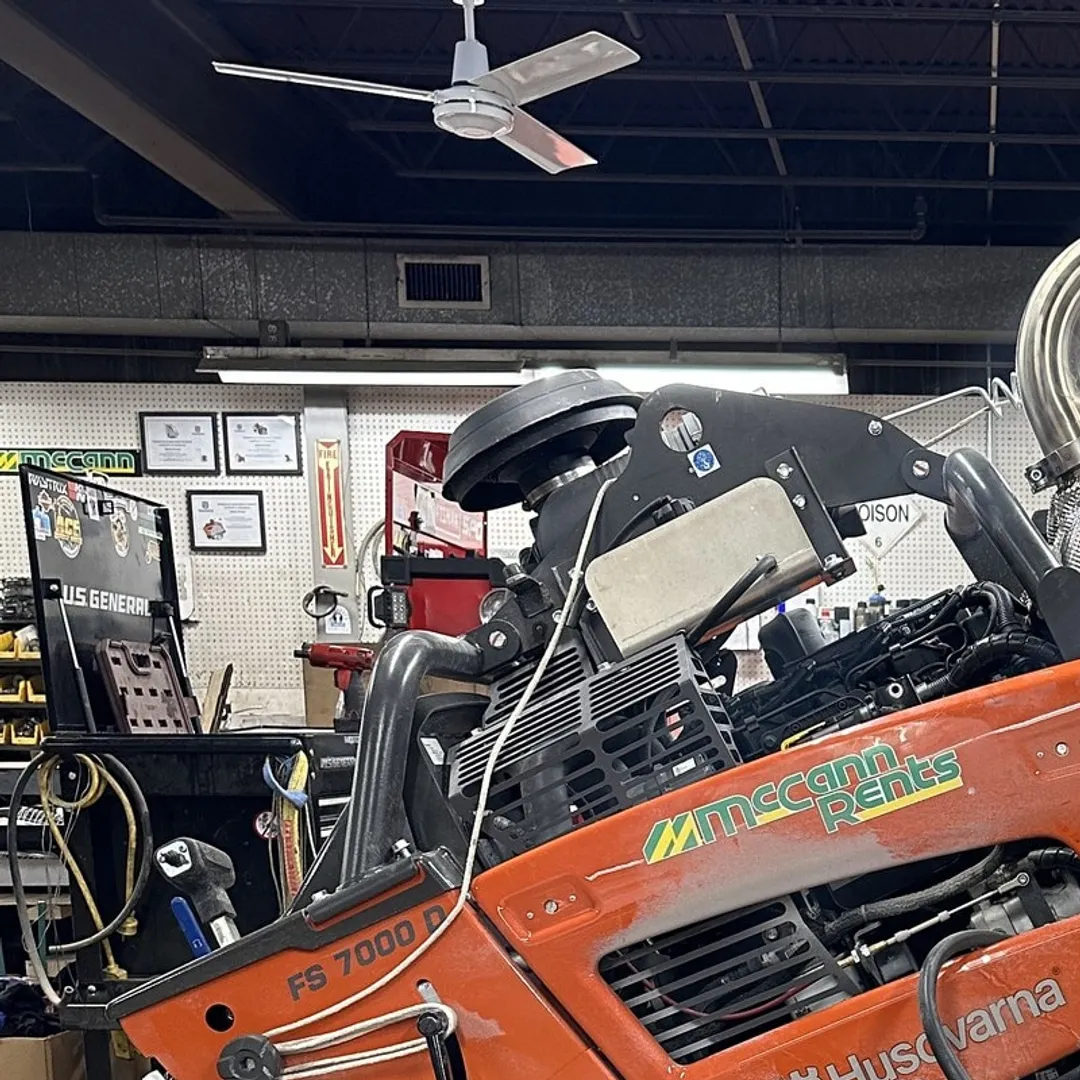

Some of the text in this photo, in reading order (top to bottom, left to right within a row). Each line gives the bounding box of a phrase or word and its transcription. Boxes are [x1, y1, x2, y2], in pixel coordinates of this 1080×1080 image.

[859, 504, 909, 523] OISON
[875, 536, 883, 548] 6
[89, 588, 151, 617] GENERAL
[816, 749, 962, 835] Rents
[287, 904, 447, 1001] FS 7000 D
